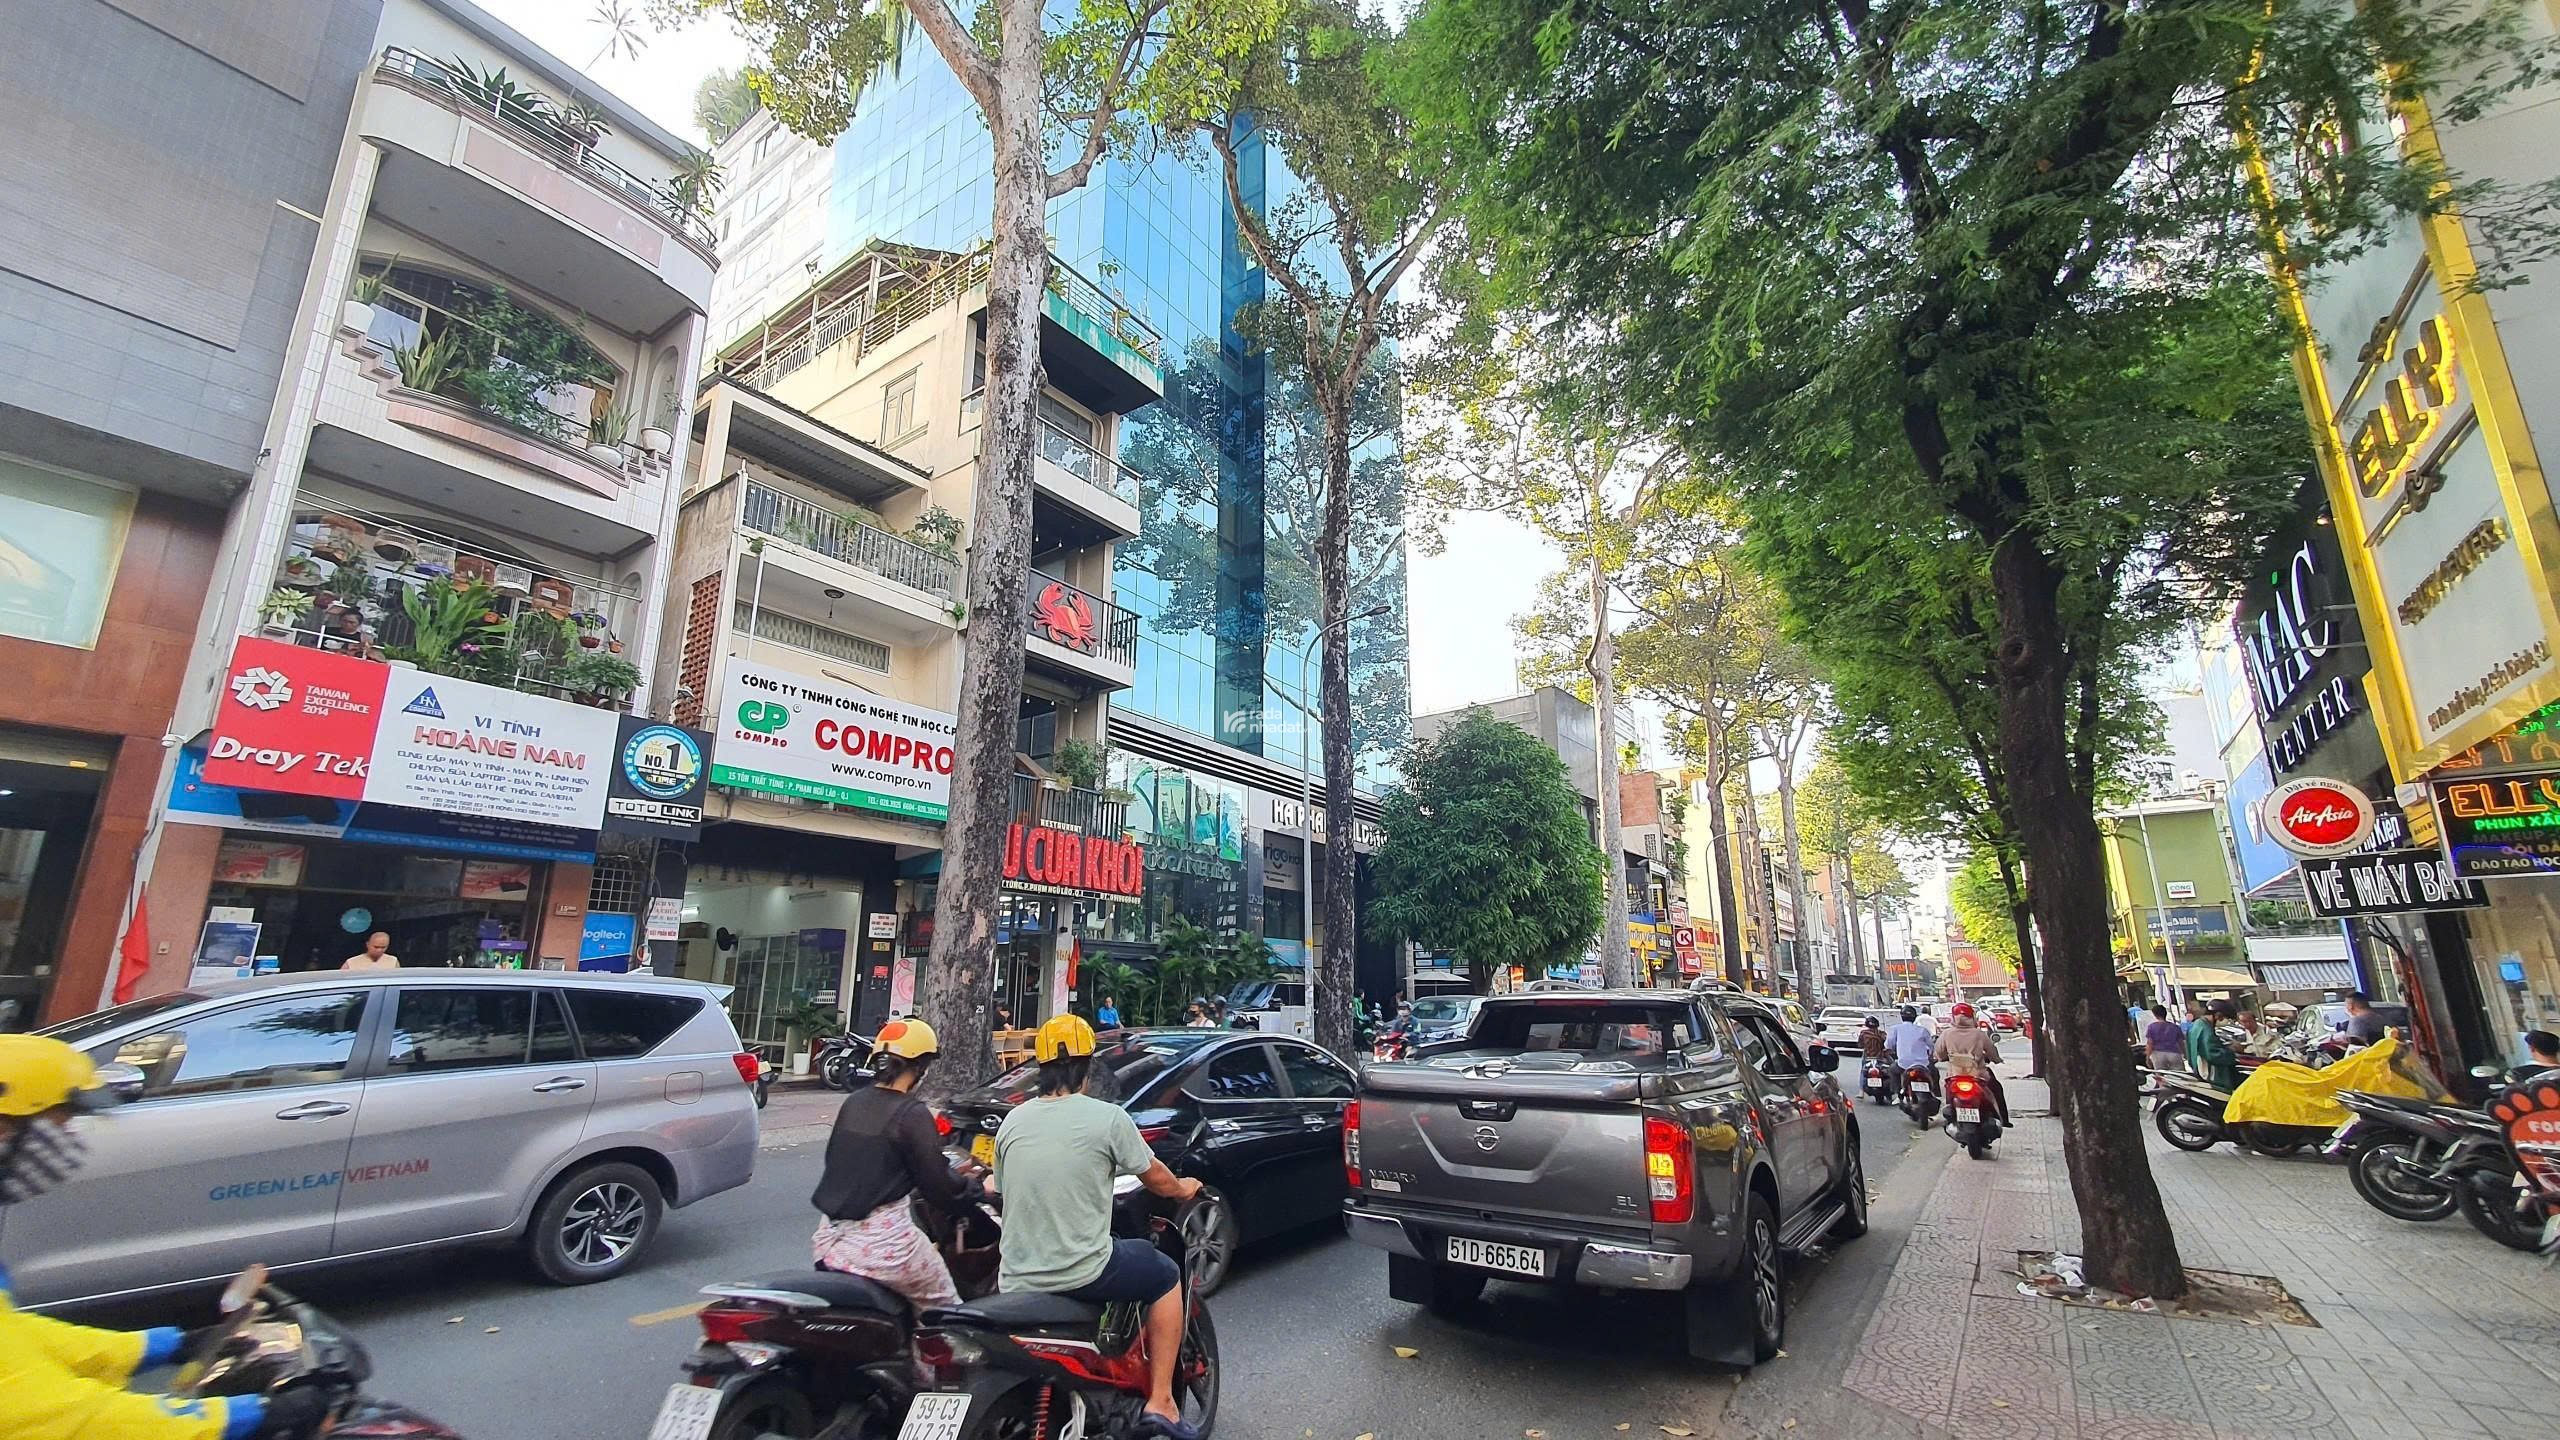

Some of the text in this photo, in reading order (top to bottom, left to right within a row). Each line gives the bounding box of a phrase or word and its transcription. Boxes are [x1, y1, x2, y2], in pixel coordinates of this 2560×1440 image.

[306, 685, 351, 700] TAIWAN
[741, 673, 778, 692] CÔNG
[781, 683, 798, 697] TY
[801, 688, 833, 707] TNHH
[835, 696, 867, 714] CÔNG
[869, 705, 899, 724] NGHỆ
[901, 714, 919, 727] TIN
[920, 719, 943, 734] HỌC
[302, 704, 329, 717] 2014
[305, 695, 369, 714] EXCELLENCE
[407, 704, 446, 717] COMPUTER
[474, 715, 540, 738] VI TÍNH
[737, 700, 792, 735] CP
[2272, 675, 2351, 774] CENTER
[414, 725, 586, 770] HOÀNG NAM
[735, 730, 788, 748] COMPRO
[815, 719, 956, 775] COMPRO
[210, 736, 305, 773] Dray
[313, 751, 370, 778] Tek
[397, 750, 423, 760] CUNG
[473, 761, 482, 769] VI
[534, 771, 544, 779] IN
[551, 774, 569, 783] LINH
[645, 754, 665, 769] NO.
[666, 743, 681, 770] 1
[470, 771, 506, 783] LAPTOP
[535, 781, 549, 790] PIN
[551, 784, 583, 794] LAPTOP
[728, 771, 736, 780] 15
[831, 762, 932, 791] www.compro.vn
[2320, 781, 2344, 791] ngay
[540, 791, 574, 803] CAMERA
[1040, 819, 1082, 833] RESTAURANT
[2286, 804, 2354, 829] AirAsia
[2474, 816, 2525, 831] PHUN
[2473, 831, 2545, 844] MAKEUP
[1026, 827, 1081, 887] CUA
[2471, 859, 2500, 870] ĐÀO
[2310, 860, 2351, 910] VÉ
[2350, 856, 2412, 907] MÁY
[583, 928, 627, 942] logitech
[975, 1005, 985, 1014] 29
[210, 1158, 430, 1201] GREEN LEAF VIETNAM
[1616, 1195, 1638, 1207] EL
[1450, 1237, 1541, 1273] 51D-665.64
[916, 1397, 961, 1420] 59-C3
